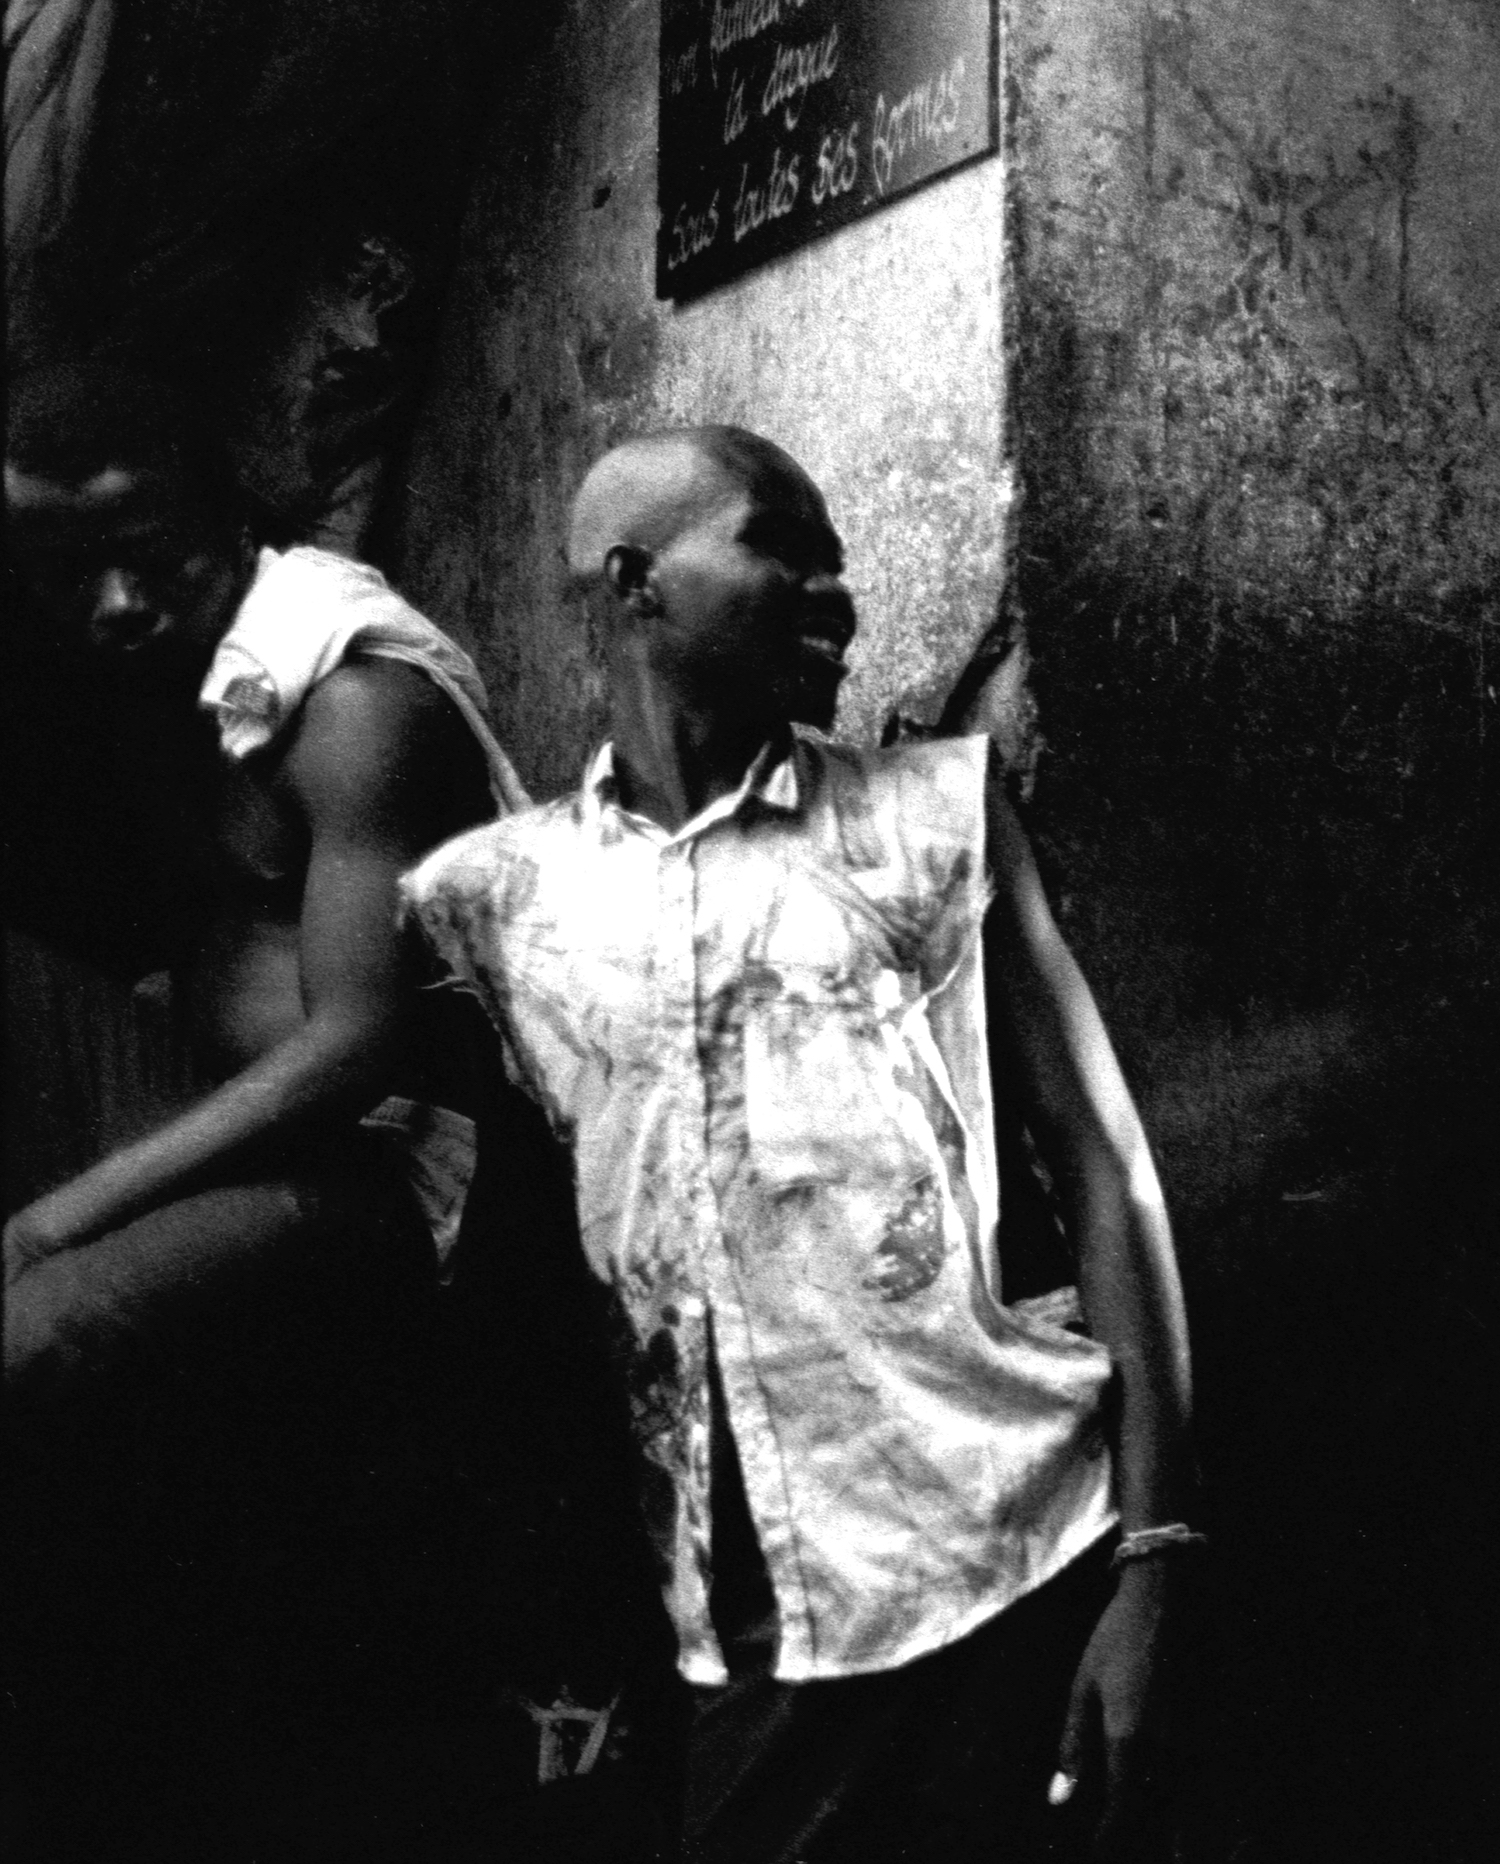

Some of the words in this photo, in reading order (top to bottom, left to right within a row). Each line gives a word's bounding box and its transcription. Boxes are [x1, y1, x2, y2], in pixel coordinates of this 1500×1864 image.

[725, 67, 748, 145] la
[763, 23, 839, 131] drogue
[734, 148, 799, 243] toutes
[812, 121, 858, 205] ses
[872, 57, 966, 196] formes
